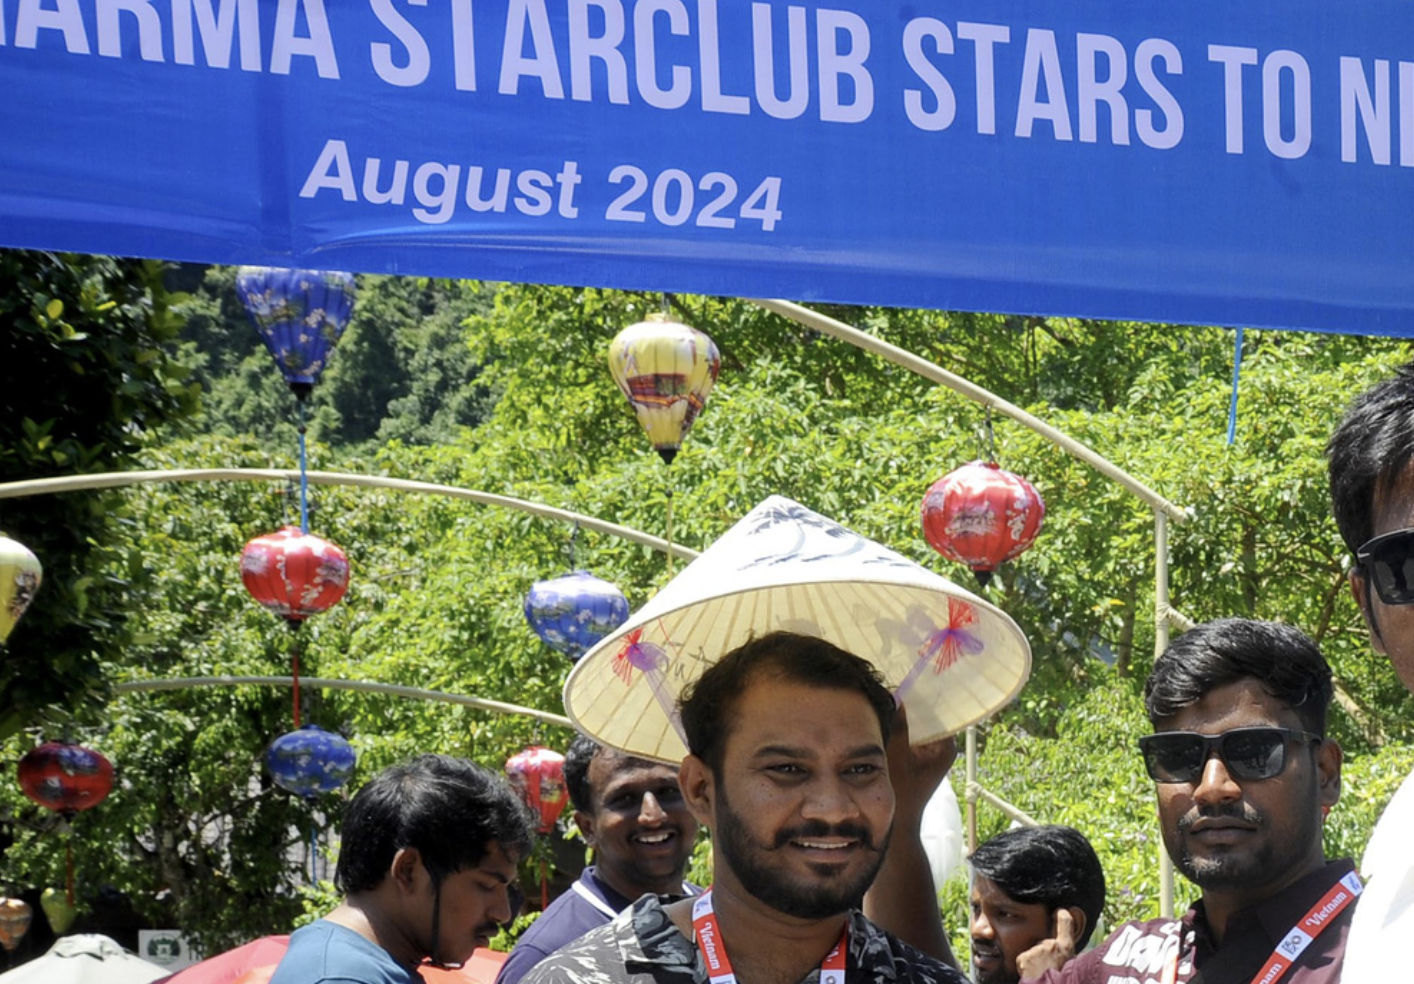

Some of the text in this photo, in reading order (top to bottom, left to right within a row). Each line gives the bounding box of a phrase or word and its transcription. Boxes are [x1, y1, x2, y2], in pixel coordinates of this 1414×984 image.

[0, 0, 340, 79] ARMA
[369, 0, 874, 123] STARCLUB
[903, 16, 1184, 150] STARS
[1208, 45, 1312, 159] TO
[300, 139, 782, 232] August 2024
[1305, 891, 1348, 928] Vietnam
[699, 922, 721, 970] Vietnam
